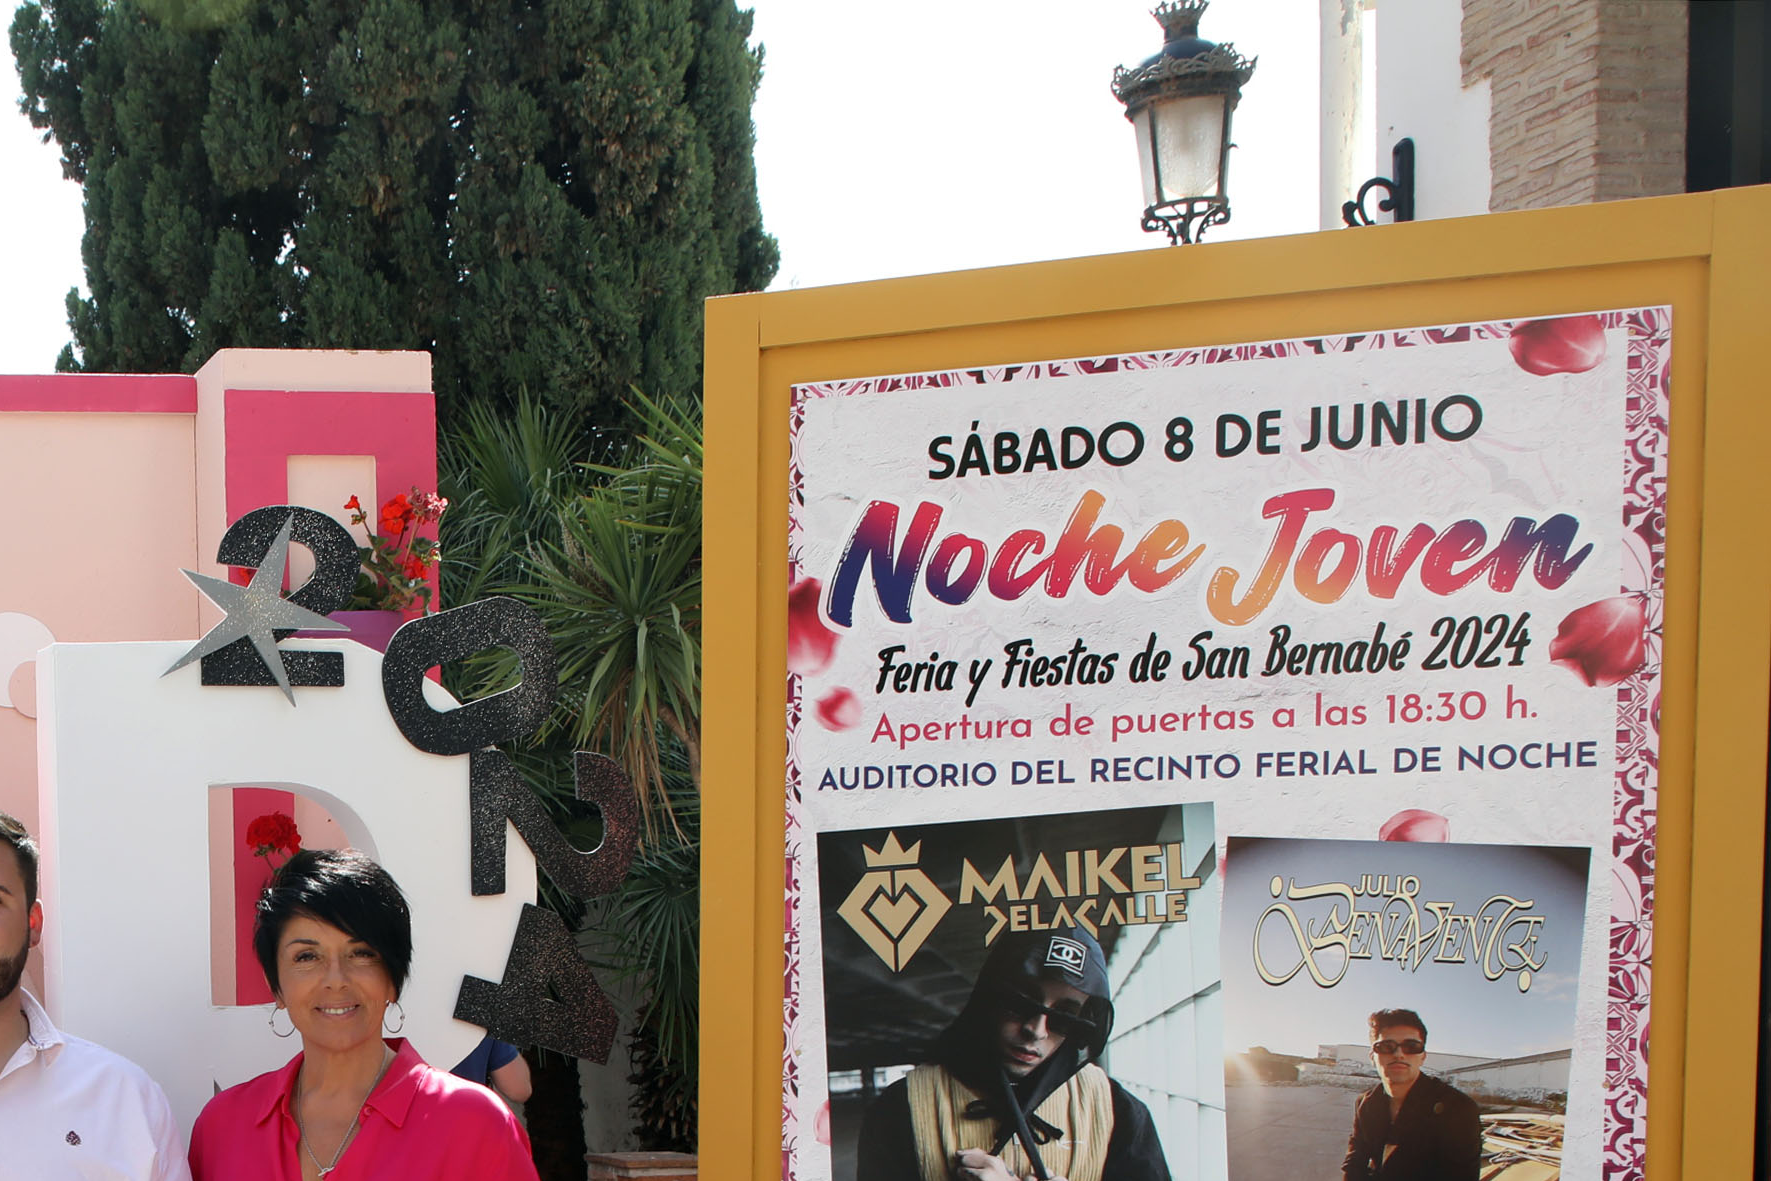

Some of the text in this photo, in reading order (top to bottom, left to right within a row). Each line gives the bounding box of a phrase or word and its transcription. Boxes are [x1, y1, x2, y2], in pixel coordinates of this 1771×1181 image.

[928, 394, 1483, 480] SÁBADO 8 DE JUNIO
[828, 487, 1594, 627] Noche Joven
[875, 611, 1532, 708] Feria y Fiestas de San Bernabé 2024
[870, 684, 1538, 751] Apertura de puertas a las 18:30 h.
[201, 504, 639, 1066] 2024
[818, 740, 1598, 792] AUDITORIO DEL RECINTO FERIAL DE NOCHE
[959, 843, 1201, 905] MAIKEL
[1352, 874, 1420, 898] JULIO
